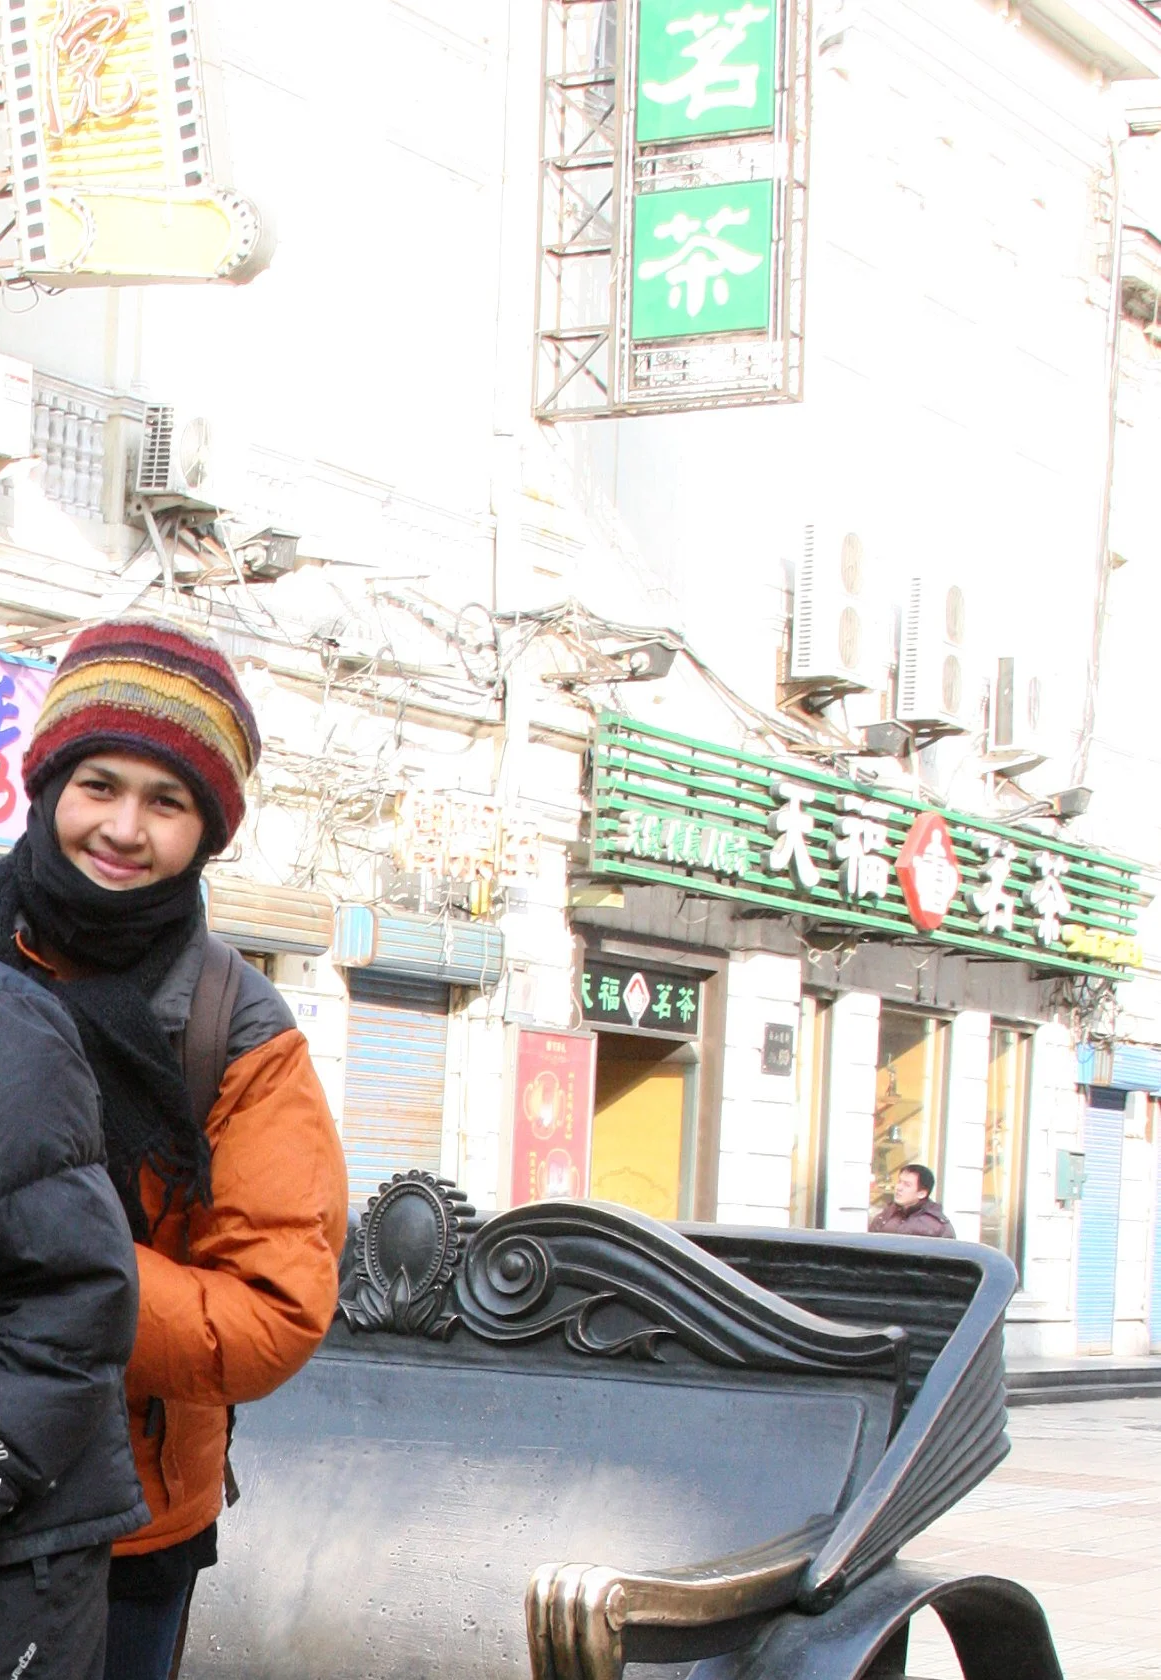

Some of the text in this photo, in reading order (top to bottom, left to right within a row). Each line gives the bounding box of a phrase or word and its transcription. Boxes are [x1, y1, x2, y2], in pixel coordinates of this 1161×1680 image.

[638, 3, 771, 318] 茗茶
[761, 781, 1073, 948] 天福 茗茶
[651, 982, 697, 1024] 茗茶
